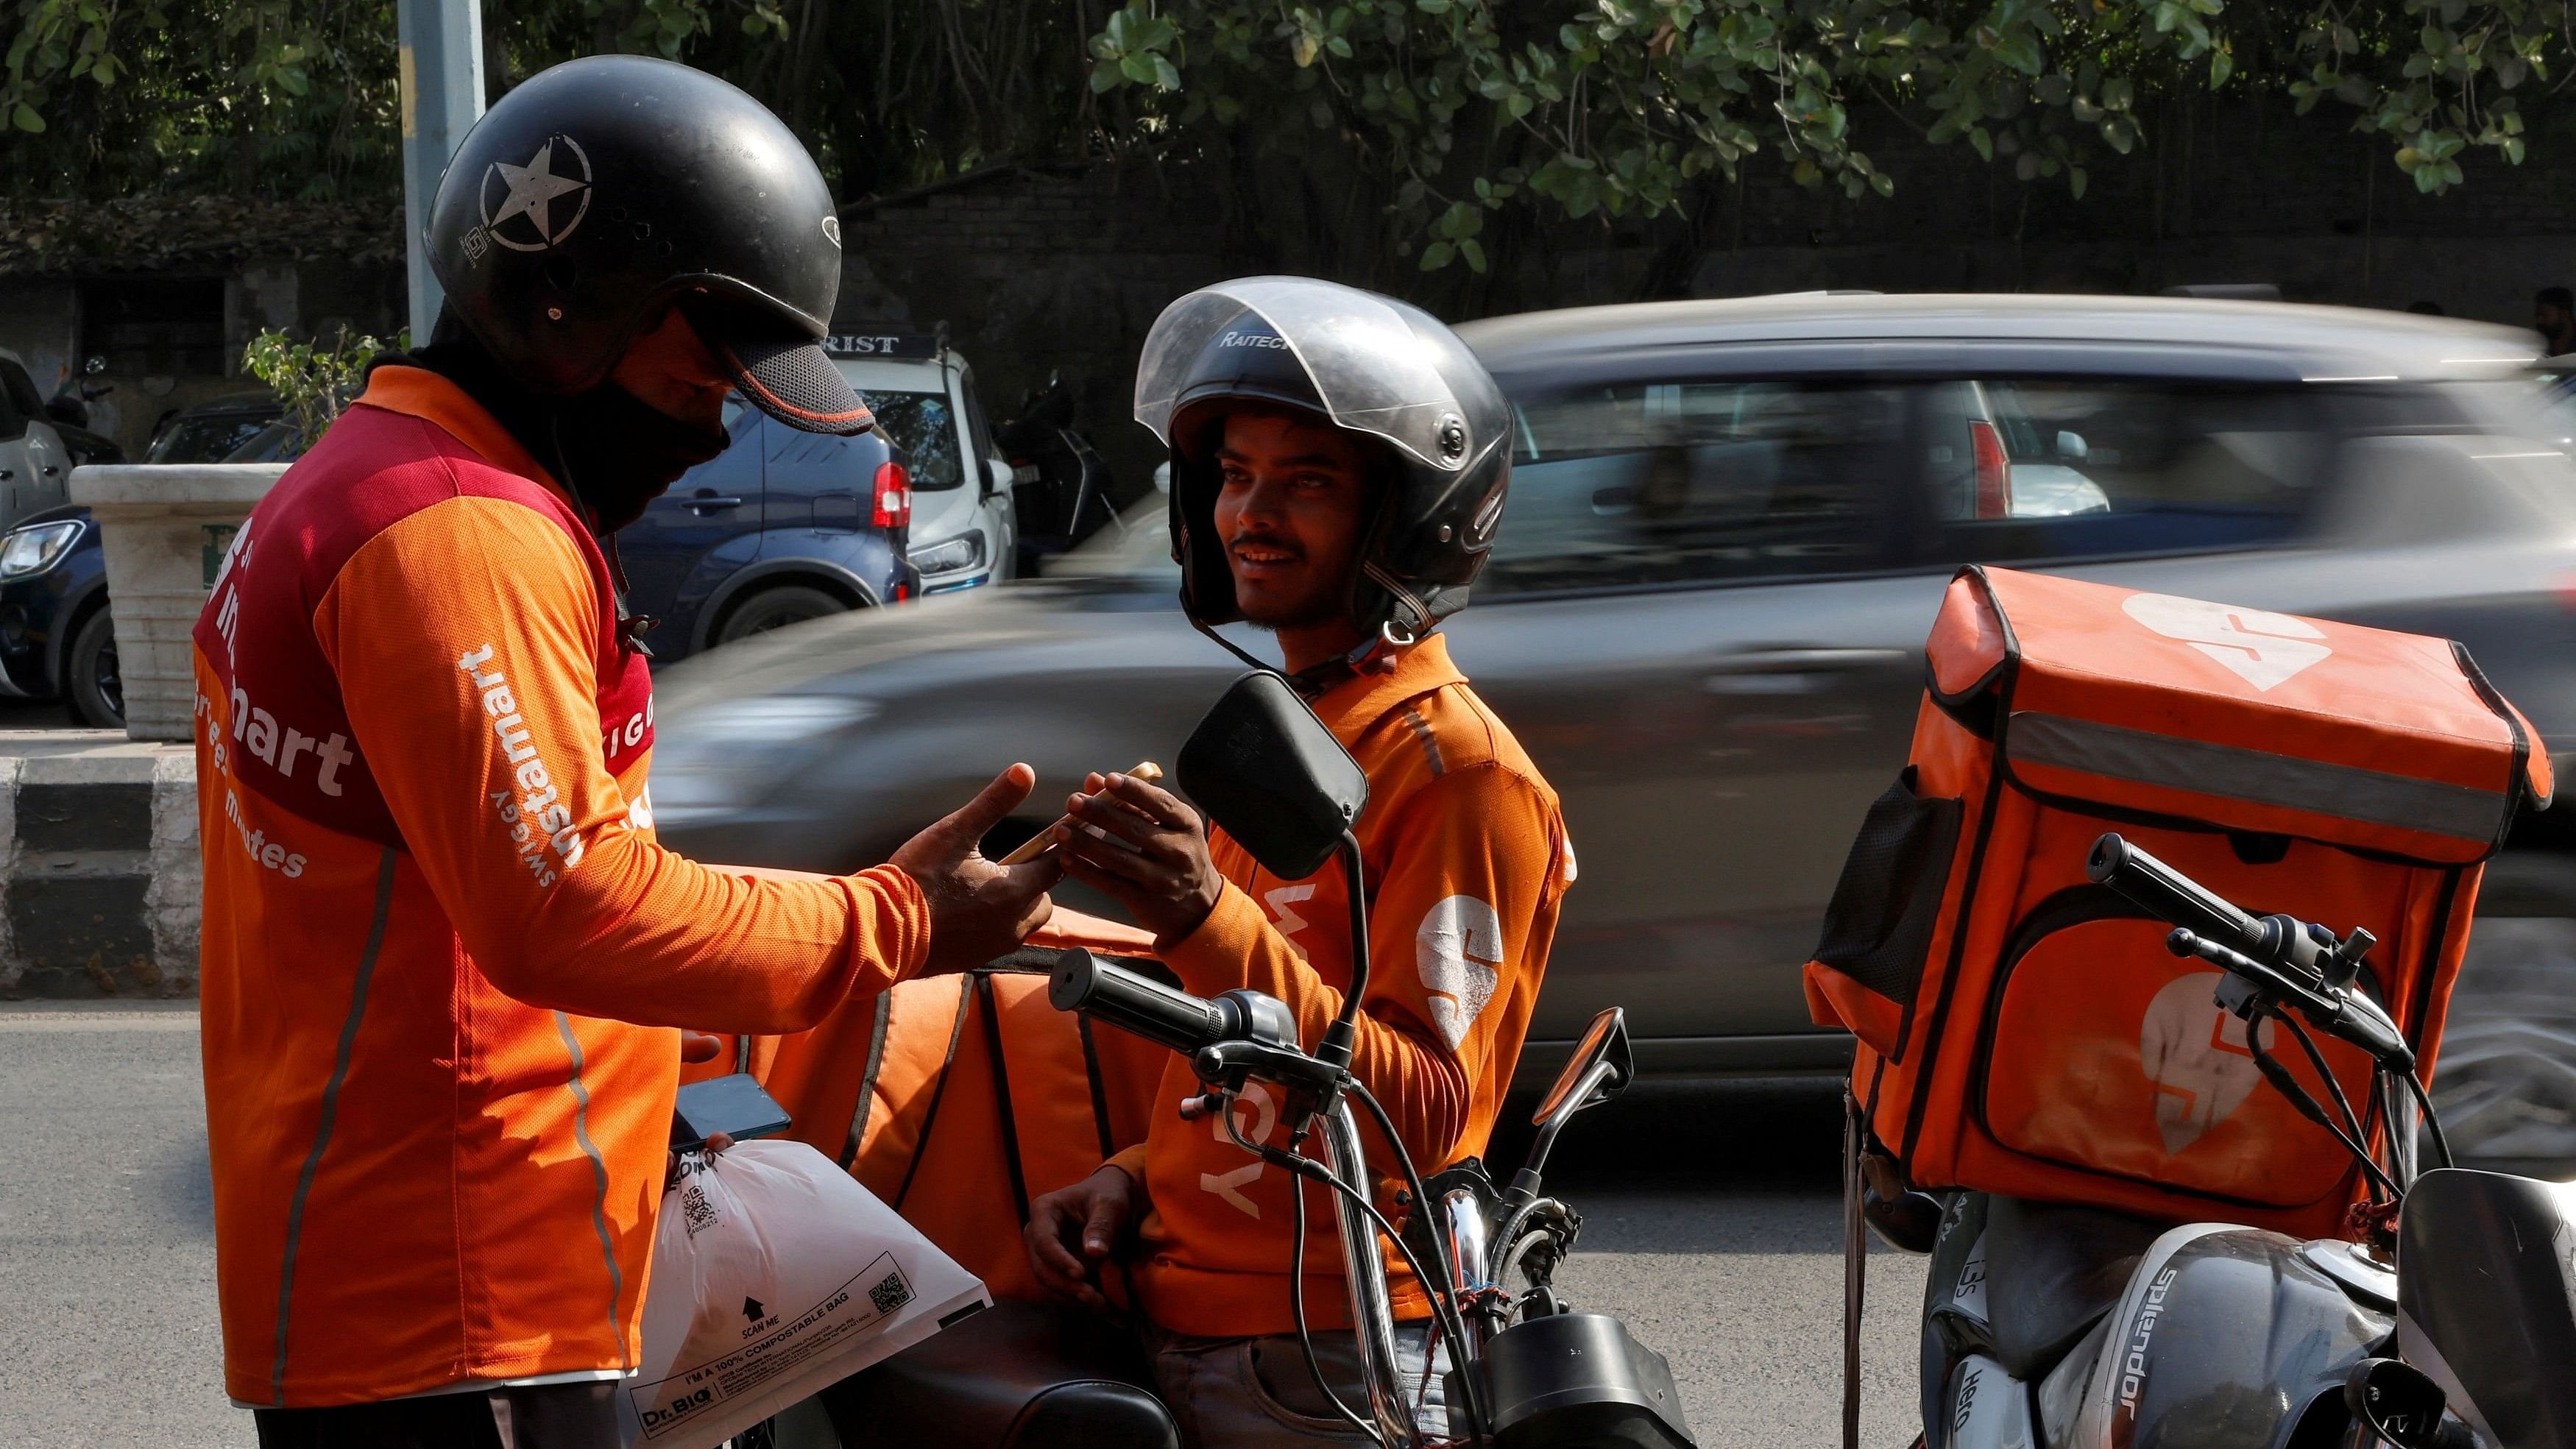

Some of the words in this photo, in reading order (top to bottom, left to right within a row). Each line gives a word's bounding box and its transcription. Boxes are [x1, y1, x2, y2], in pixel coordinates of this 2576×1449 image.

[489, 789, 556, 888] SWIGGY
[685, 1372, 703, 1385] I'M
[705, 1368, 714, 1377] A
[715, 1355, 743, 1371] 100%
[745, 1308, 826, 1357] COMPOSTABLE
[826, 1292, 849, 1311] BAG
[742, 1323, 765, 1339] SCAN
[766, 1314, 780, 1328] ME
[1954, 1369, 1984, 1434] Hero
